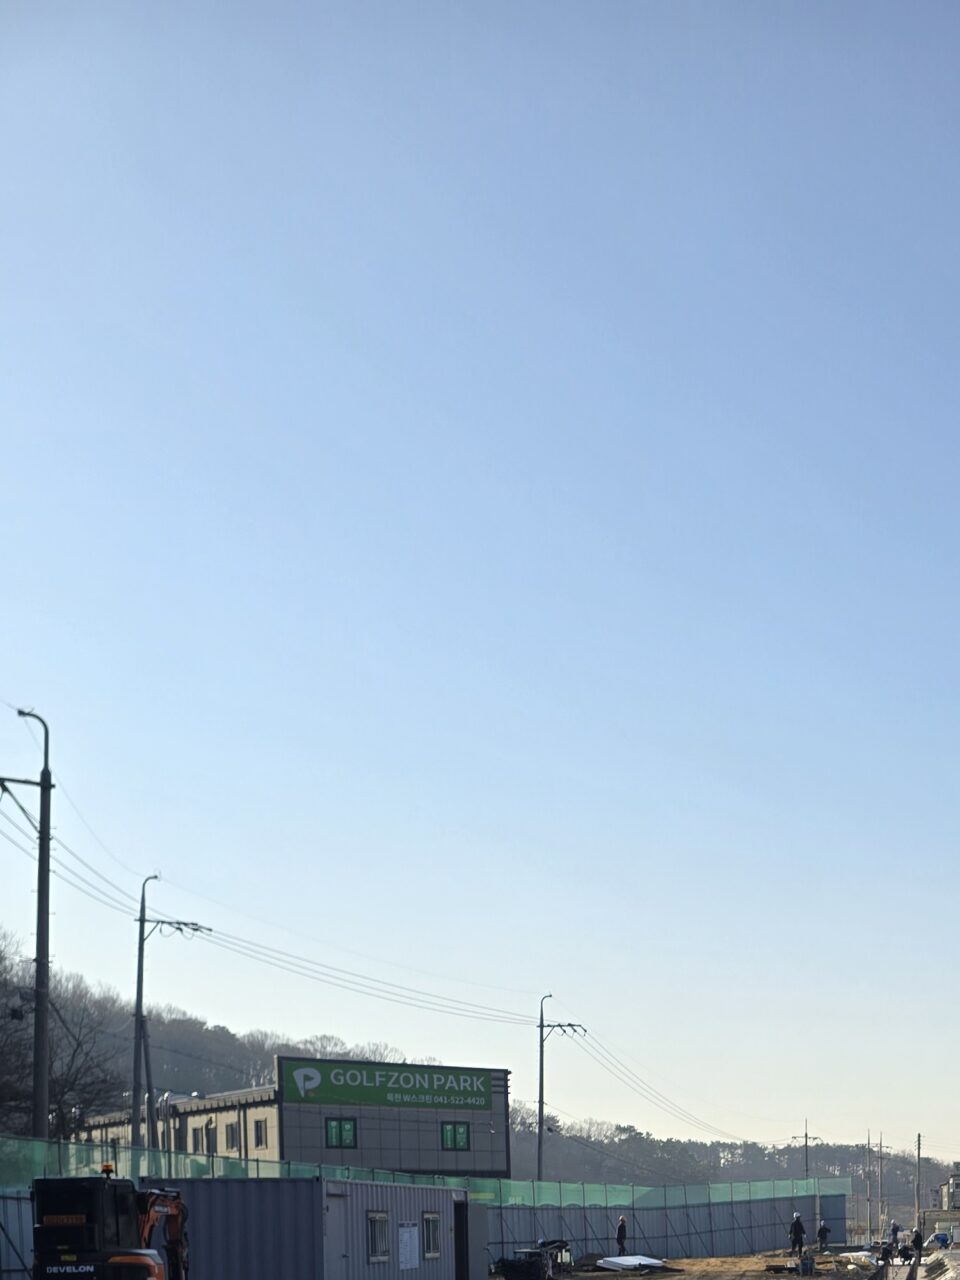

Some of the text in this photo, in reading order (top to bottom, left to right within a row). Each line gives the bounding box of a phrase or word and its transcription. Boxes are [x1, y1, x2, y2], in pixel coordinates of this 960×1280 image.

[330, 1069, 485, 1092] GOLFZON PARK
[46, 1265, 95, 1274] DEVELON
